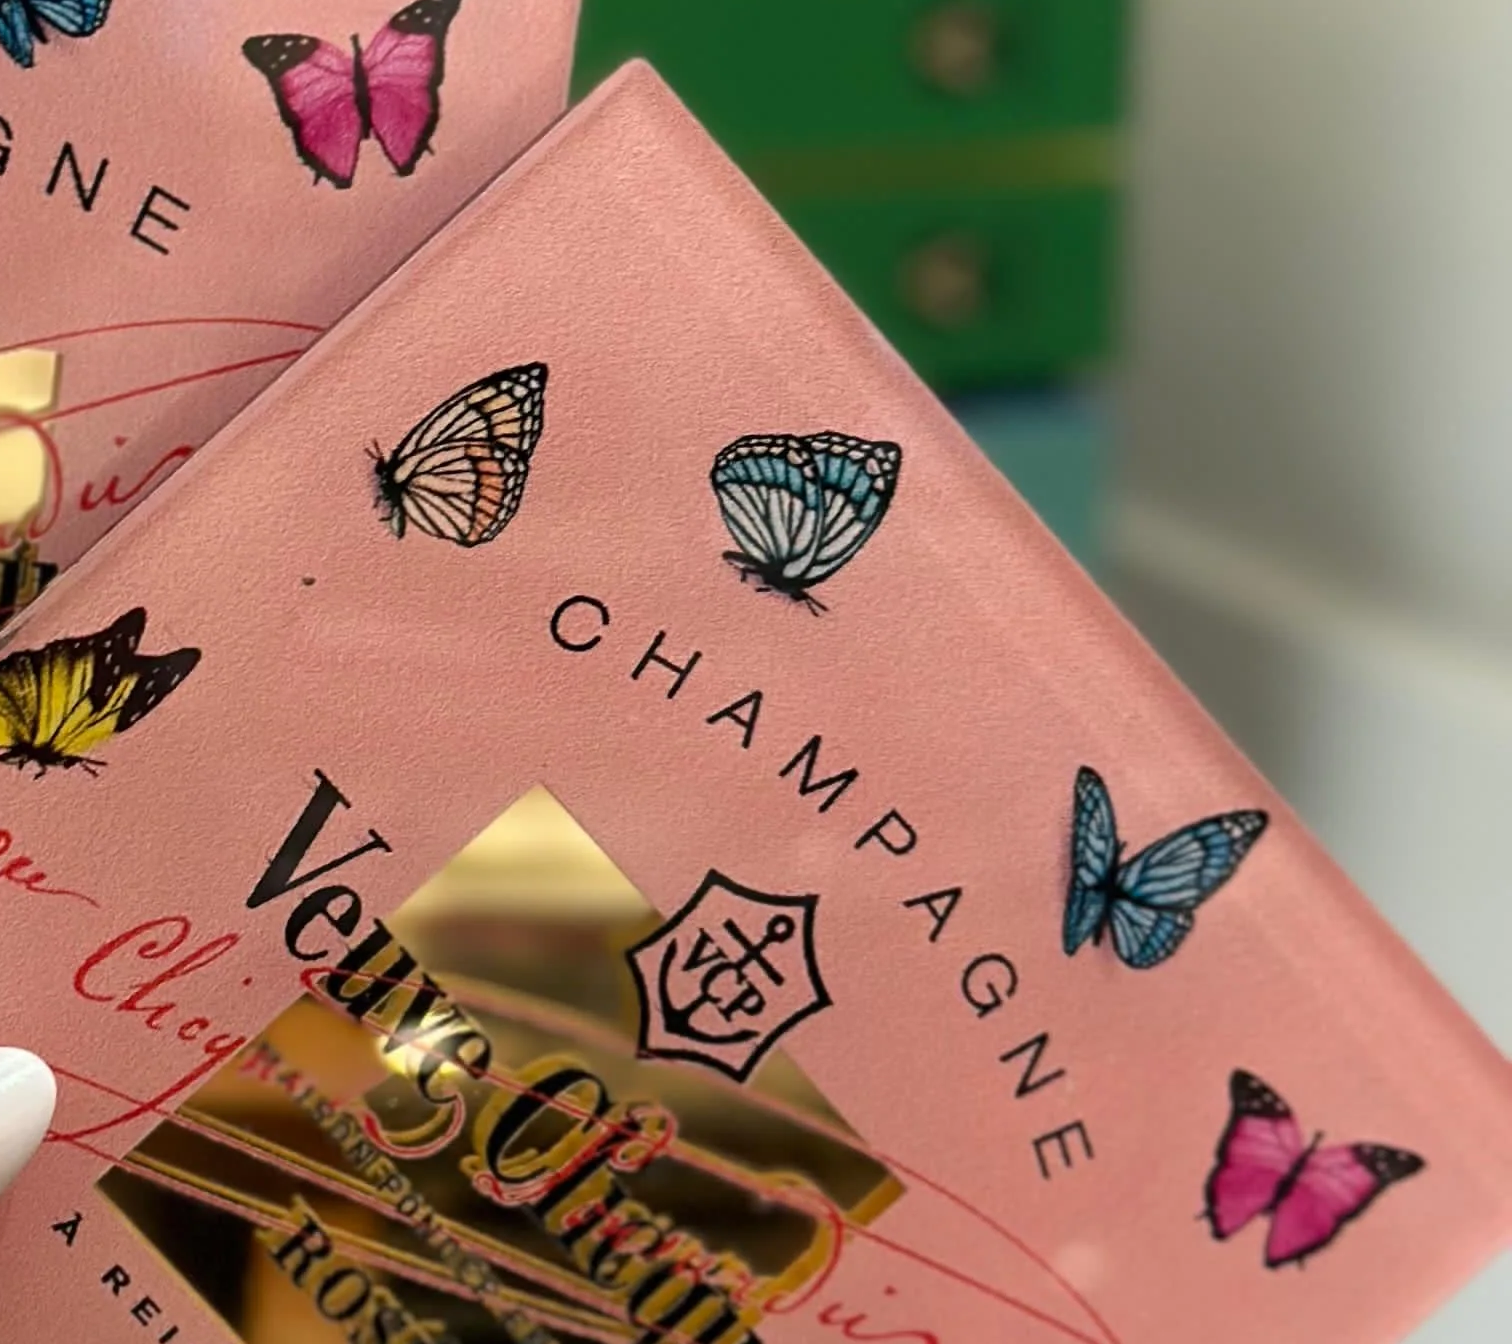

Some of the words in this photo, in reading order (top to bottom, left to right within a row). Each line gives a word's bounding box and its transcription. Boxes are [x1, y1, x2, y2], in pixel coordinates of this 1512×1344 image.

[245, 768, 492, 1104] Veuve
[549, 594, 1095, 1180] CHAMPAGNE
[681, 925, 765, 1023] VCP
[51, 1211, 84, 1248] À
